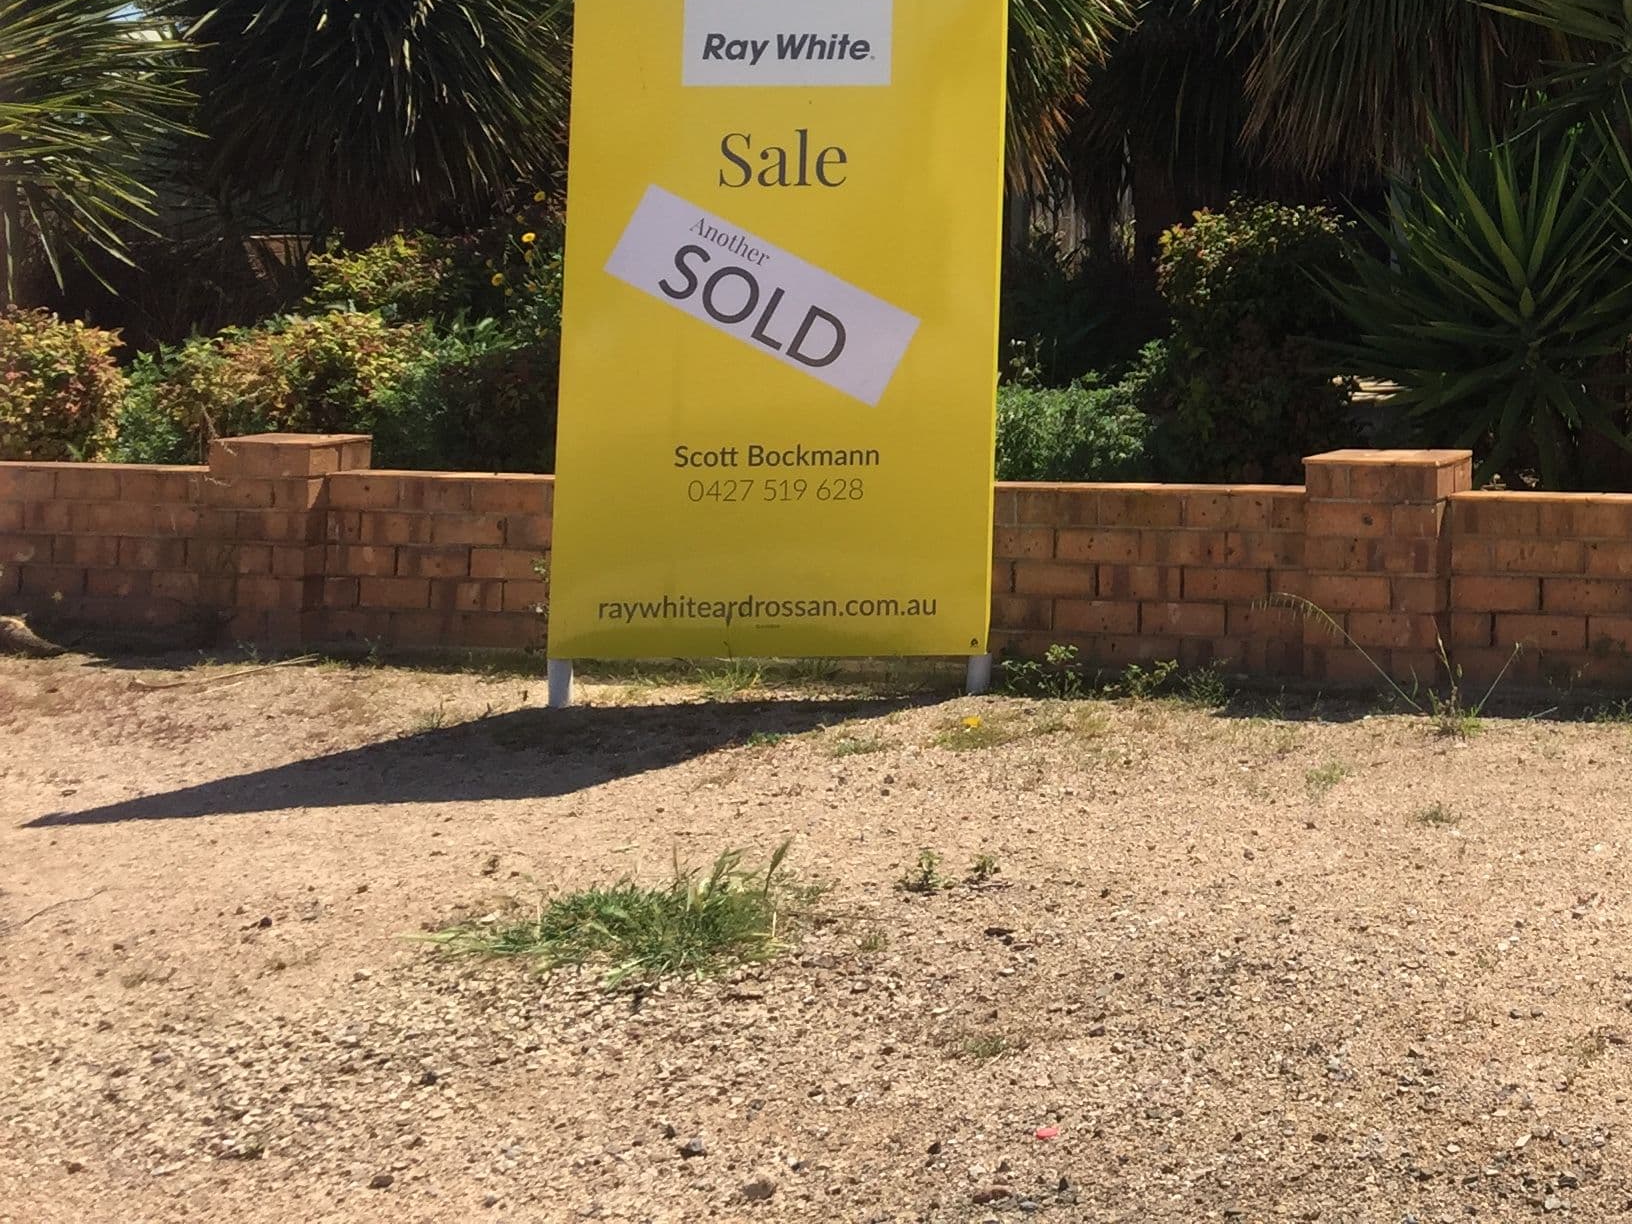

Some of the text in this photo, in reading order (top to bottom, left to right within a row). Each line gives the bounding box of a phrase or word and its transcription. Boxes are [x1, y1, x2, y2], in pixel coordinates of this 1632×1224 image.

[702, 33, 871, 65] Ray White
[718, 129, 847, 188] Sale
[688, 215, 771, 267] Another
[657, 244, 847, 368] SOLD
[674, 443, 880, 469] Scott Bockmann
[688, 478, 864, 502] 0427 519 628
[598, 594, 938, 623] raywhiteardrossan.com.au
